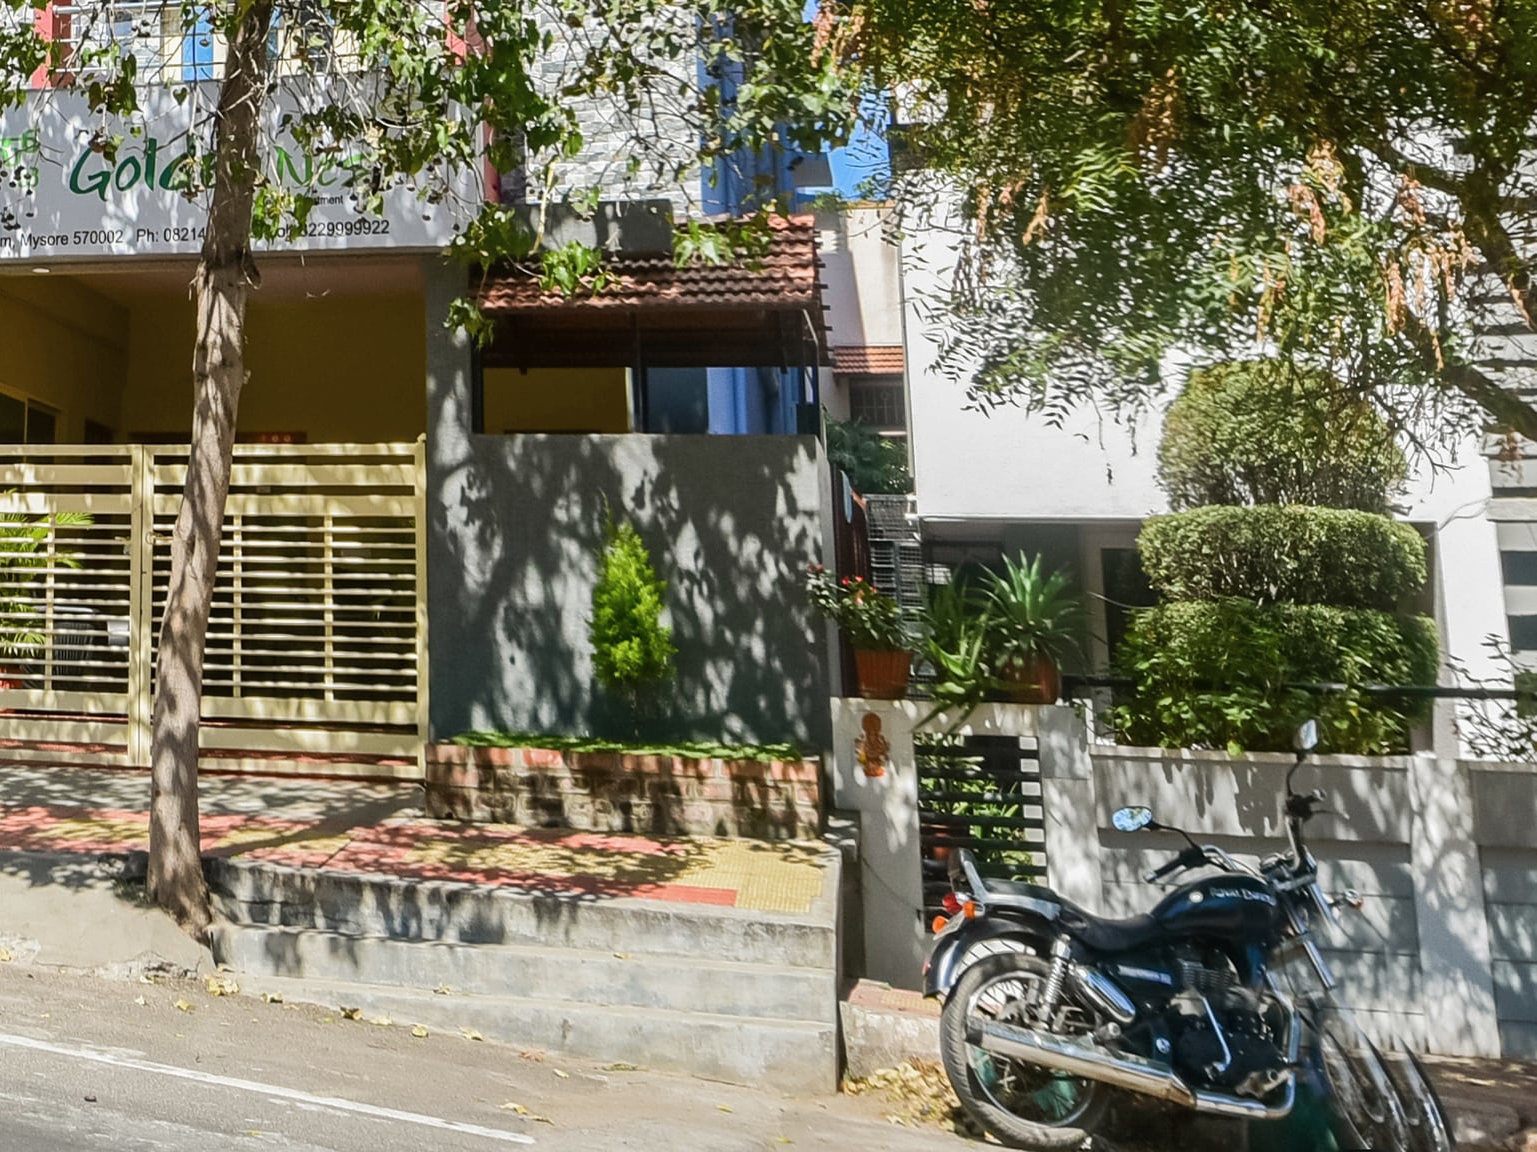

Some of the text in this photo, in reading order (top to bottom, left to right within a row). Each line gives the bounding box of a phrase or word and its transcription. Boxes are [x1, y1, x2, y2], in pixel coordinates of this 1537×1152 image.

[20, 232, 69, 250] Mysore
[73, 230, 124, 245] 570002
[136, 228, 159, 243] Ph:
[163, 227, 206, 242] 08214
